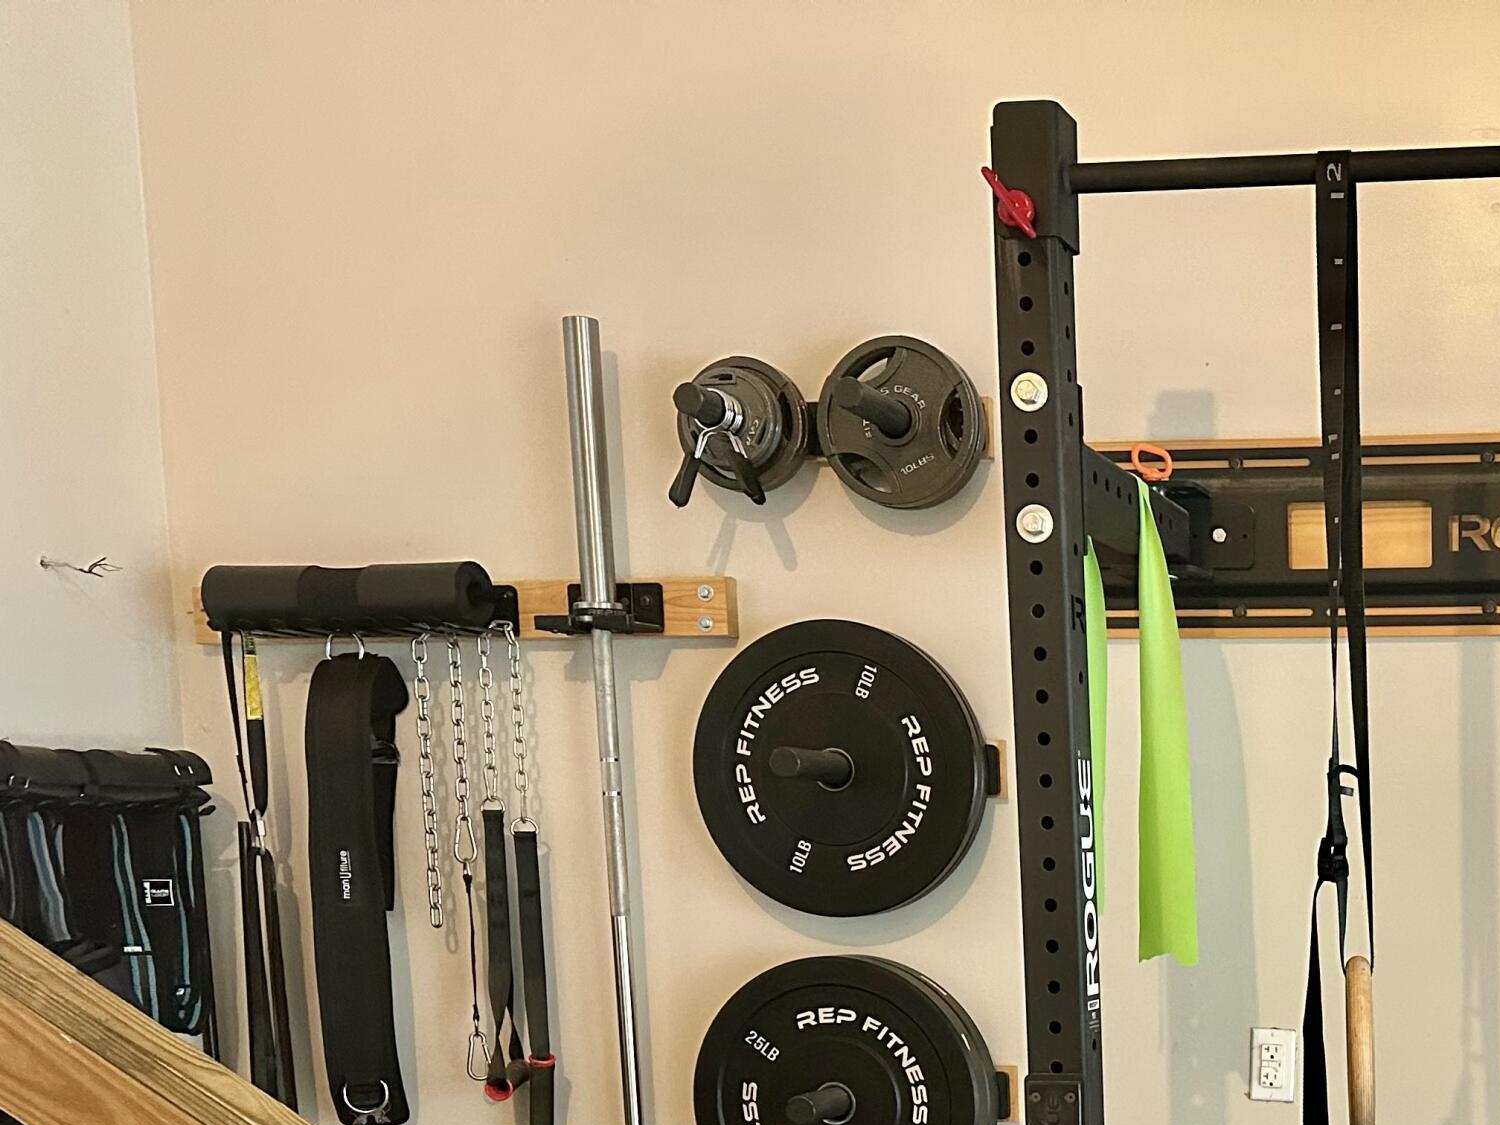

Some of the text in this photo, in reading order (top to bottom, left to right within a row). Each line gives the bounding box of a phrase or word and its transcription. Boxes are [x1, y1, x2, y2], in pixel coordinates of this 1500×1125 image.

[1327, 163, 1342, 181] 2
[893, 385, 928, 410] GEAR
[900, 452, 936, 476] 10LBS
[855, 664, 878, 700] 10LB
[735, 667, 820, 825] REP FITNESS
[847, 715, 933, 872] REP FITNESS
[789, 839, 812, 873] 10LB
[1077, 758, 1099, 997] ROGUE
[744, 1030, 780, 1062] 25LB
[796, 1007, 928, 1125] REP FITNESS
